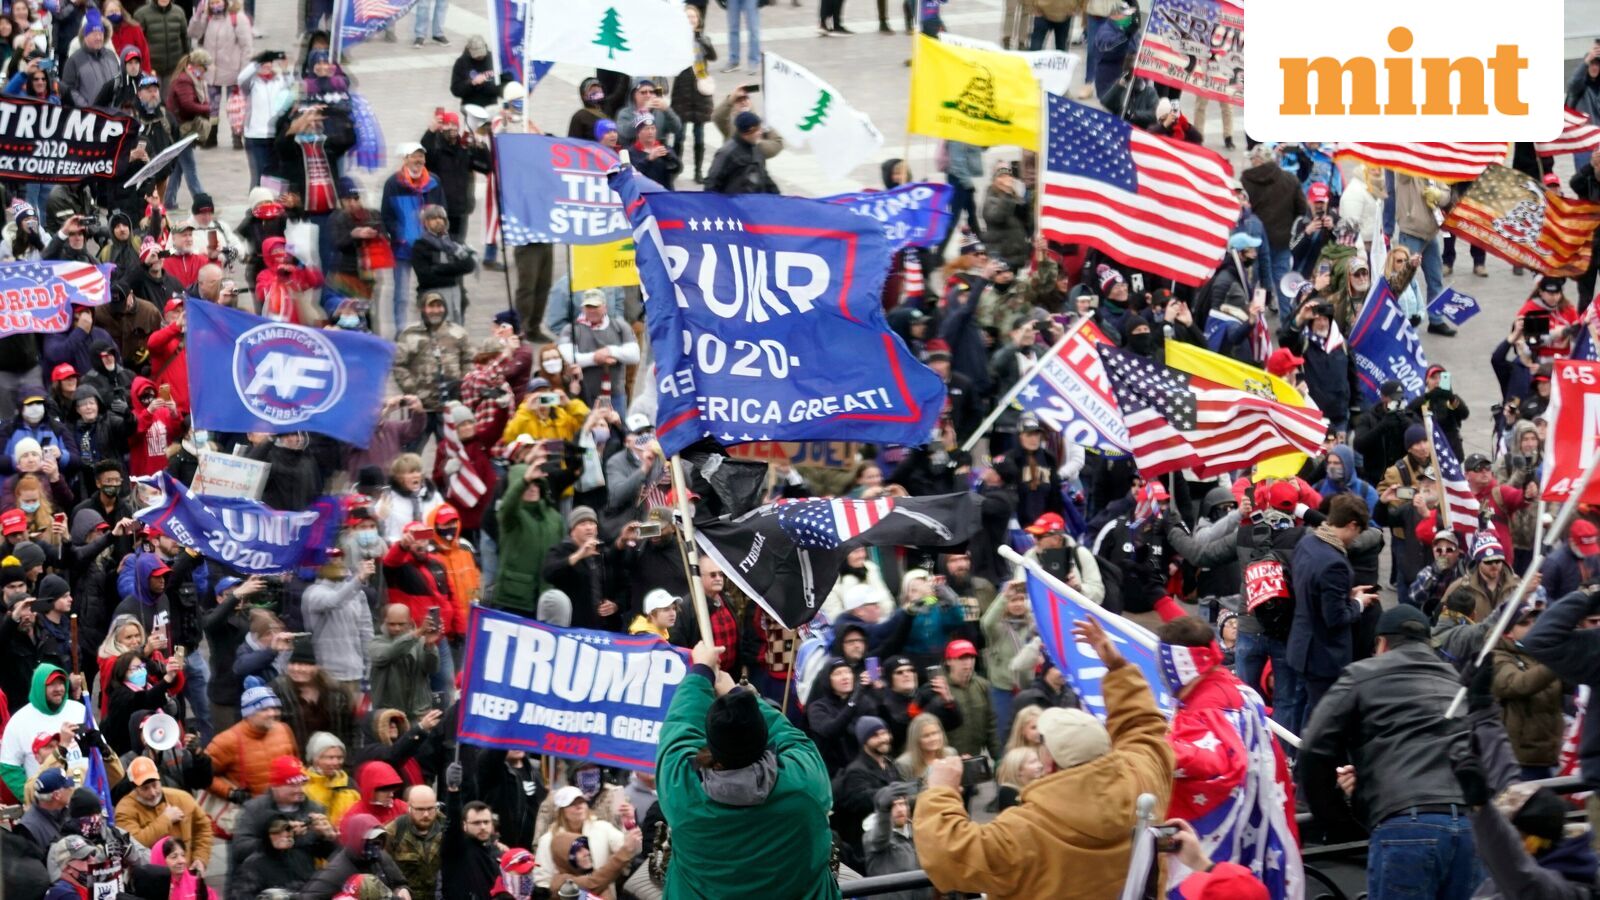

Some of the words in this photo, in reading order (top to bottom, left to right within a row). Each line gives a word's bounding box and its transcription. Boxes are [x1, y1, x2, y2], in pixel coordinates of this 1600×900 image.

[0, 102, 124, 143] TRUMP
[33, 139, 68, 159] 2020
[0, 156, 16, 171] CK
[18, 157, 55, 175] YOUR
[56, 160, 113, 176] FEELINGS
[549, 207, 633, 237] STEA
[664, 243, 830, 323] RUMP
[244, 351, 334, 400] AF
[1044, 360, 1081, 393] KEEP
[1562, 365, 1597, 385] 45
[697, 396, 782, 424] ERICA
[788, 387, 895, 422] GREAT!
[166, 515, 195, 547] KEEP
[482, 617, 688, 708] TRUMP
[470, 692, 519, 721] KEEP
[519, 702, 607, 736] AMERICA
[542, 732, 592, 757] 2020
